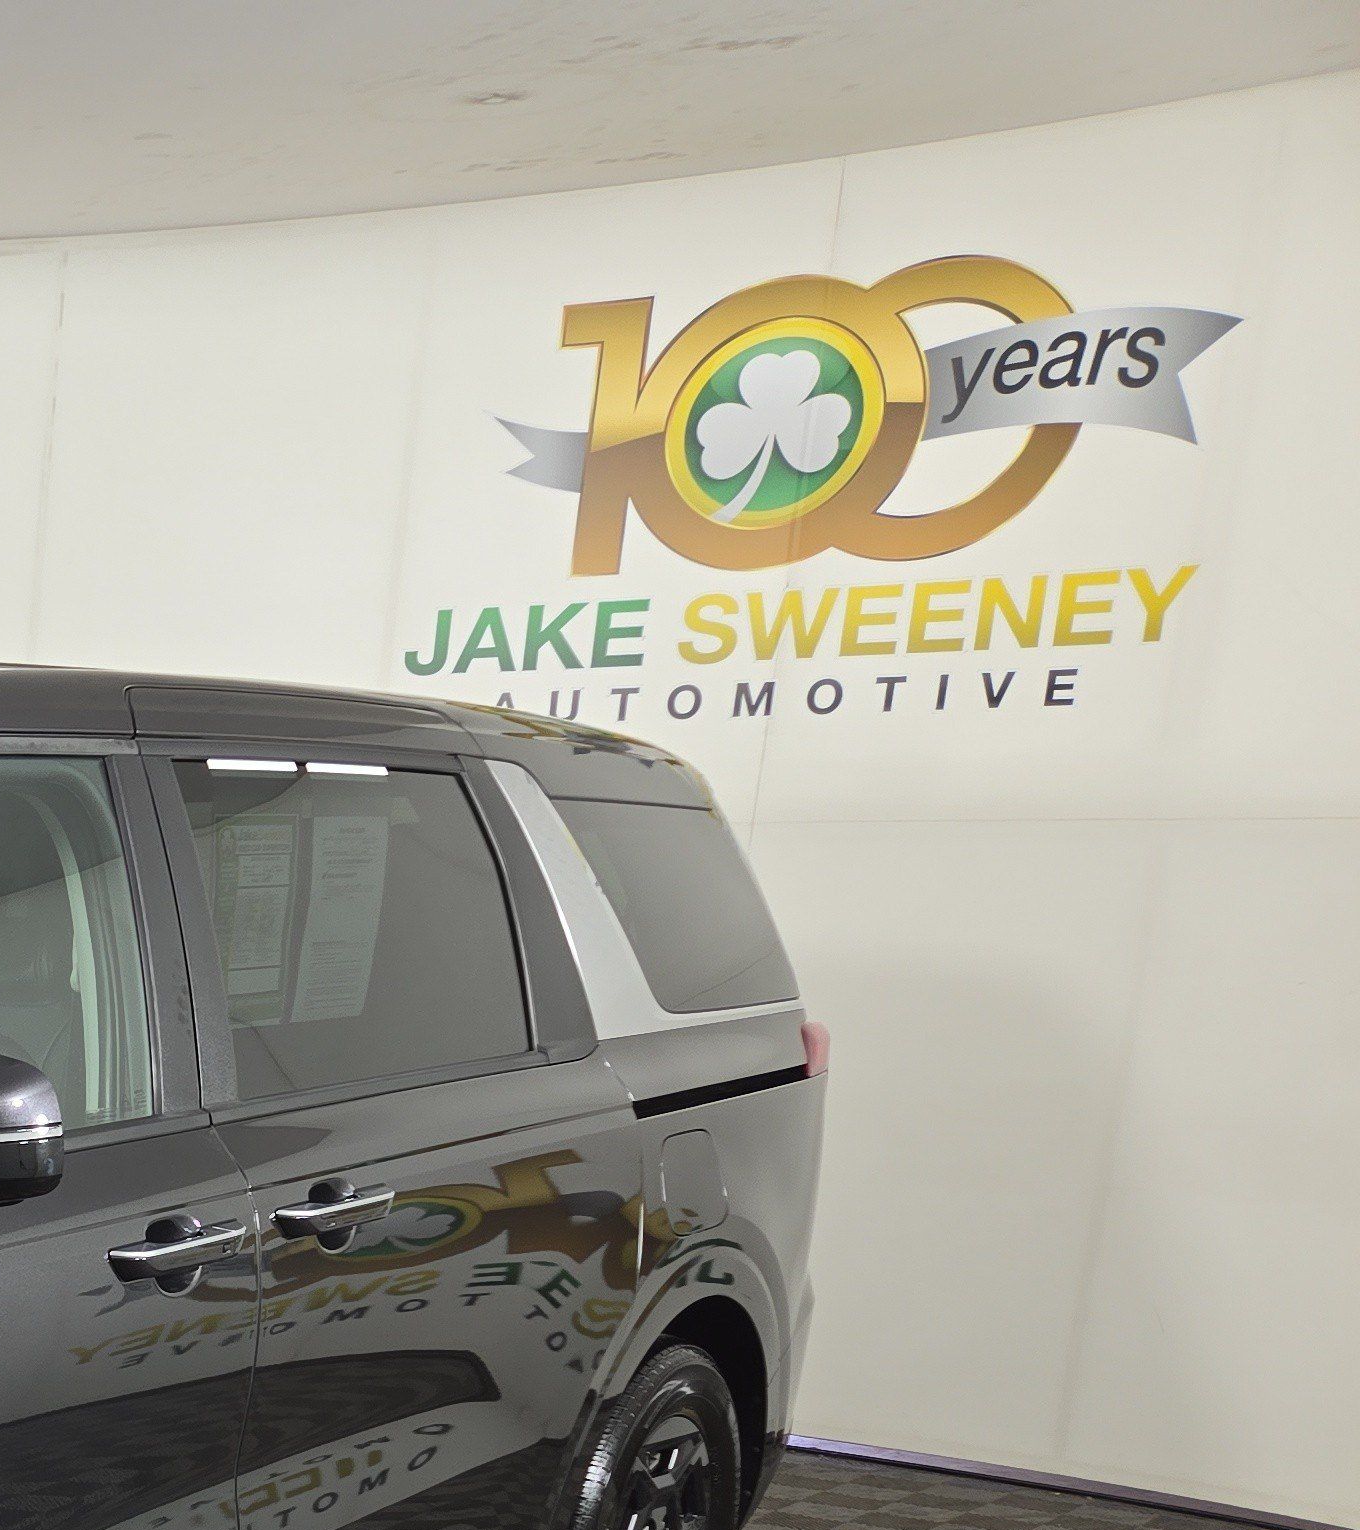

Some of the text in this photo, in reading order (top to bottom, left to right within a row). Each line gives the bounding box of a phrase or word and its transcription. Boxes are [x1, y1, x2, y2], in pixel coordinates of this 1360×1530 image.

[940, 325, 1165, 424] years
[404, 564, 1200, 674] JAKE SWEENEY
